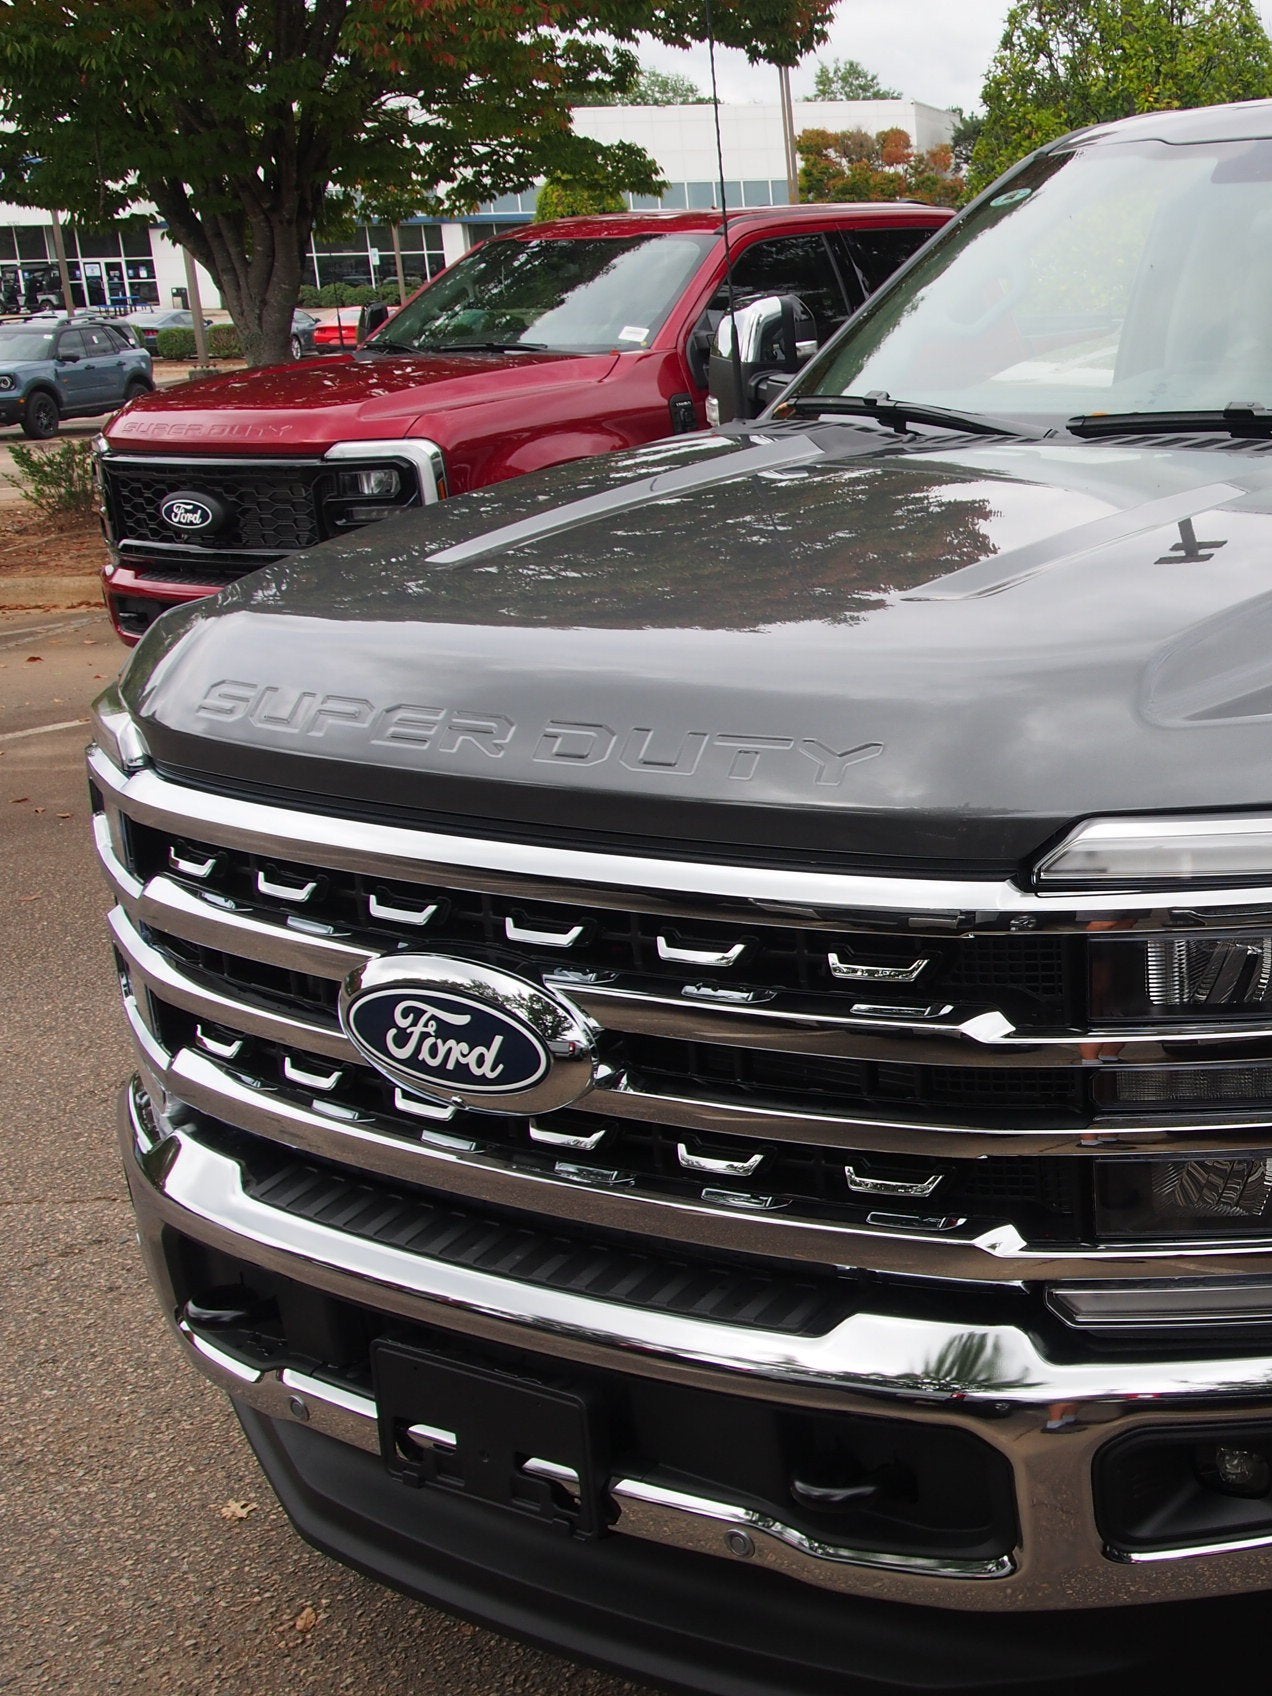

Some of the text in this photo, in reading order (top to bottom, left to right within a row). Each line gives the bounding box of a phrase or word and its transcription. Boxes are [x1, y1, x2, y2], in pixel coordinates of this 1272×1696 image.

[171, 502, 203, 525] Ford
[195, 678, 885, 787] SUPER DUTY
[385, 999, 505, 1080] Ford
